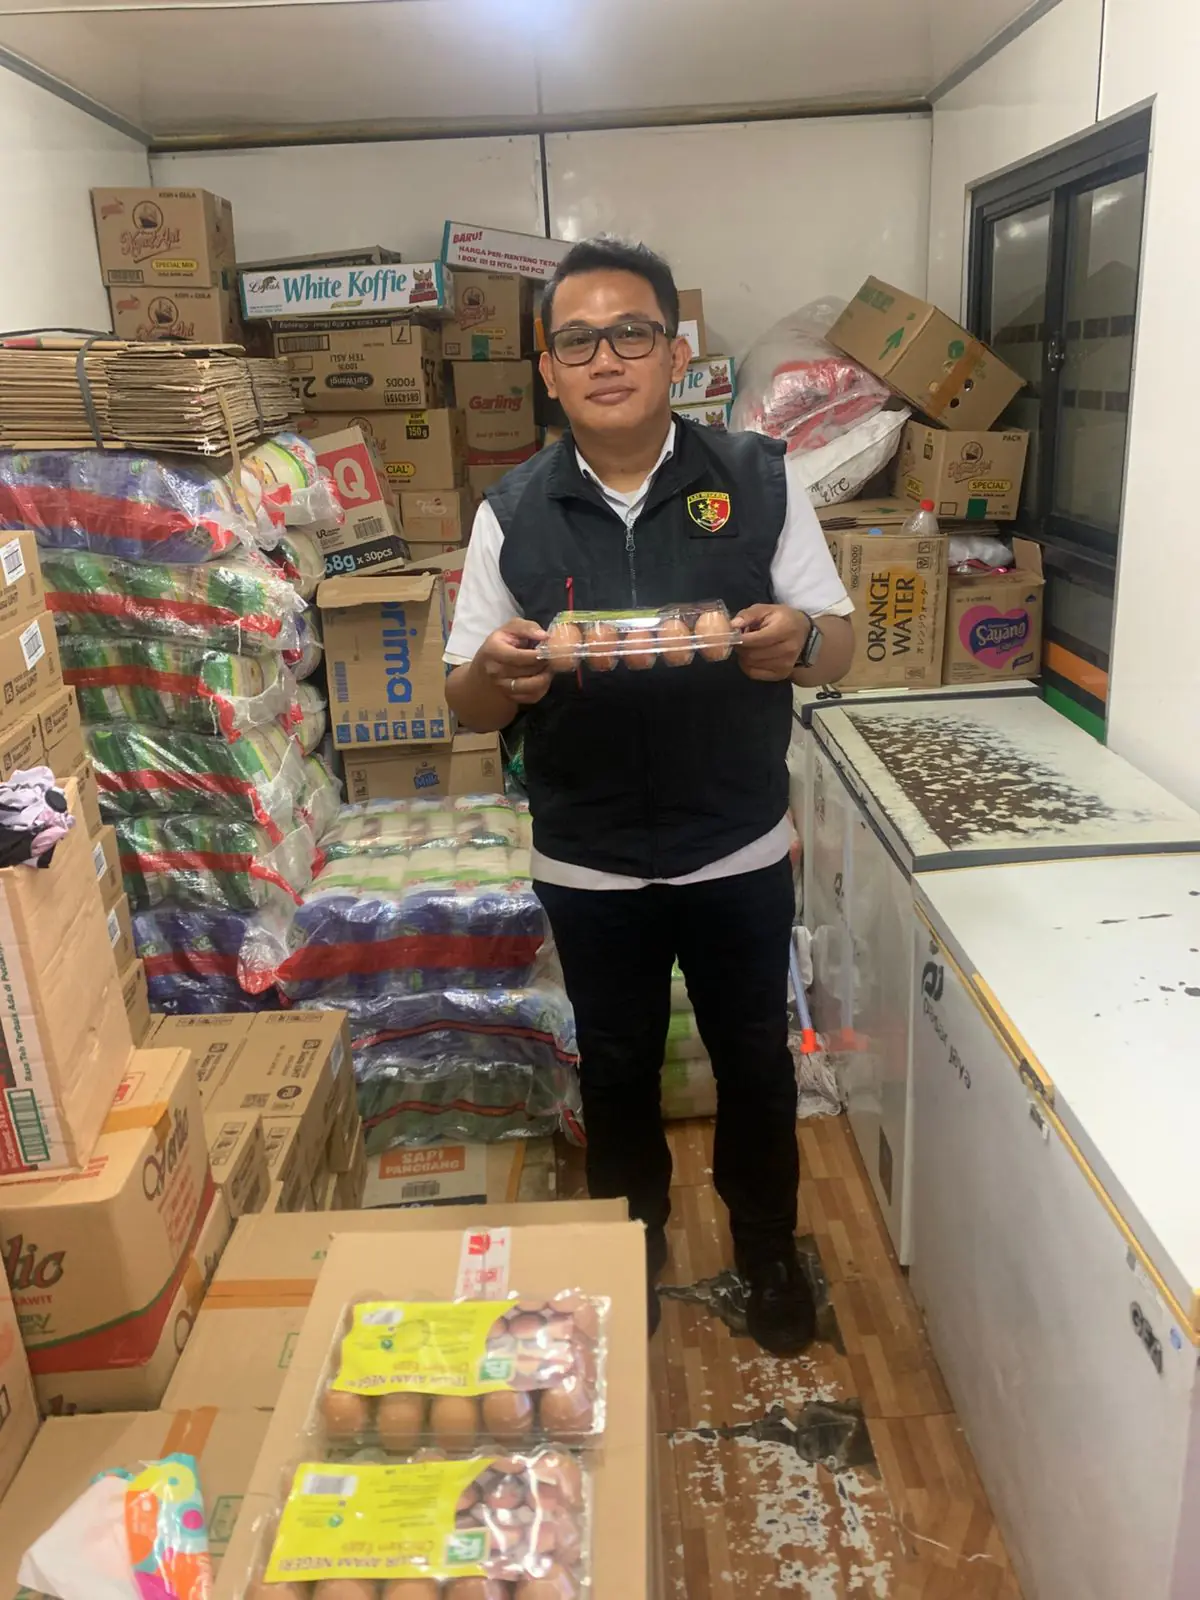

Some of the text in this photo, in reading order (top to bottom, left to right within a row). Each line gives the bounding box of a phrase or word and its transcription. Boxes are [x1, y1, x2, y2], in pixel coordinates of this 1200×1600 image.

[452, 230, 483, 244] BARU!
[458, 246, 486, 256] HARGA
[461, 255, 477, 263] BOX
[530, 267, 545, 275] PCS
[283, 273, 342, 304] White
[347, 270, 408, 300] Koffie
[396, 327, 407, 343] 7
[329, 353, 365, 362] TEH ASLI
[337, 363, 358, 371] 100%
[385, 377, 415, 388] FOODS
[408, 427, 421, 437] 150
[1002, 434, 1021, 442] PACK
[385, 465, 410, 474] CIAL
[972, 482, 1005, 490] SPECIAL
[364, 548, 393, 563] 30pcs
[866, 572, 891, 663] ORANGE
[892, 576, 916, 657] WATER
[976, 622, 1026, 646] Sayang
[380, 602, 413, 704] rima
[413, 772, 440, 790] Milk
[401, 1150, 444, 1164] SAPI
[385, 1160, 460, 1175] PANGGANG
[4, 1232, 67, 1290] lio
